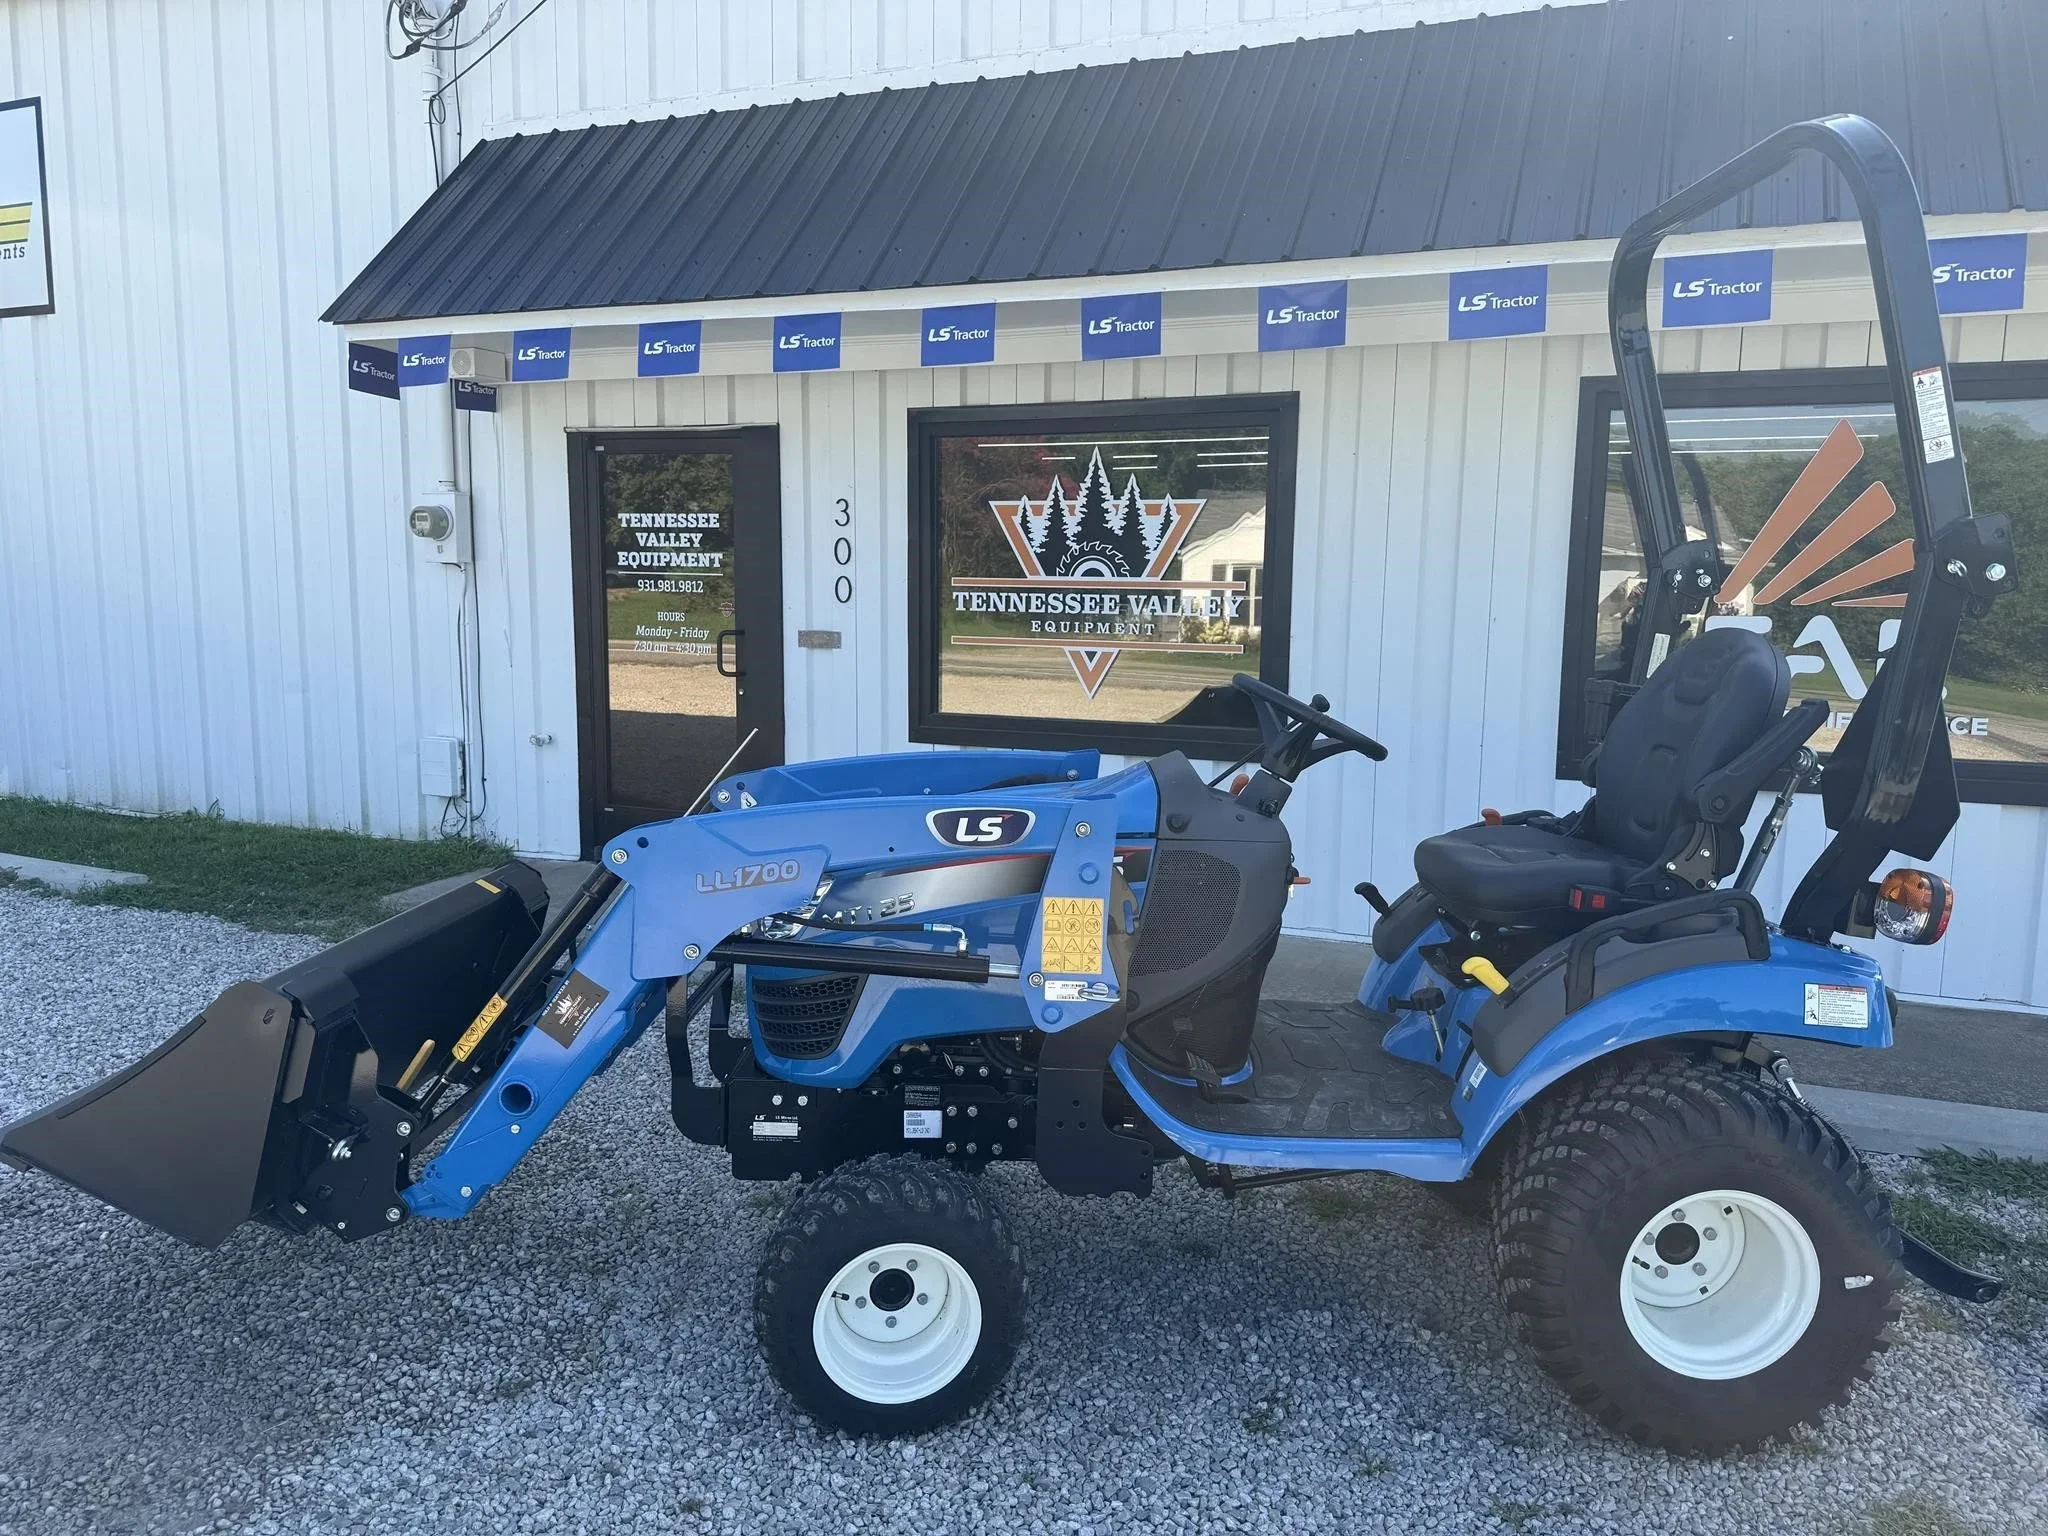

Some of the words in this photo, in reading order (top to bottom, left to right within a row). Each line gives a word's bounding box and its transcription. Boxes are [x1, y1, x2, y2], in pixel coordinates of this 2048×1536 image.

[1955, 266, 2016, 283] Tractor
[1672, 280, 1705, 298] LS
[1708, 280, 1763, 296] Tractor
[1457, 294, 1487, 312] LS
[1490, 294, 1539, 309] Tractor
[1266, 308, 1293, 325] LS
[1295, 308, 1340, 323] Tractor
[928, 327, 951, 342] LS
[953, 328, 989, 341] Tractor
[1088, 318, 1112, 335] LS
[1114, 319, 1155, 333] Tractor
[644, 341, 664, 355] LS
[665, 342, 696, 354] Tractor
[779, 335, 801, 349] LS
[802, 336, 835, 348] Tractor
[403, 354, 421, 367] LS
[421, 355, 446, 366] Tractor
[517, 348, 537, 361] LS
[537, 349, 565, 360] Tractor
[352, 359, 371, 374] LS
[370, 366, 395, 381] Tractor
[457, 382, 472, 392] LS
[472, 384, 495, 395] Tractor
[617, 513, 720, 528] TENNESSEE
[636, 532, 703, 547] VALLEY
[617, 551, 723, 568] EQUIPMENT
[637, 579, 704, 593] 931.981.9812
[952, 591, 1120, 615] TENNESSEE
[1127, 595, 1246, 618] VALLEY
[657, 612, 685, 622] HOURS
[636, 625, 672, 639] Monday
[680, 627, 710, 640] Friday
[1031, 620, 1156, 636] EQUIPMENT
[634, 640, 653, 652] 7:30
[653, 643, 668, 653] am
[676, 642, 697, 654] 4:30
[697, 645, 712, 656] pm
[956, 817, 1003, 842] LS
[696, 859, 799, 893] LL1700
